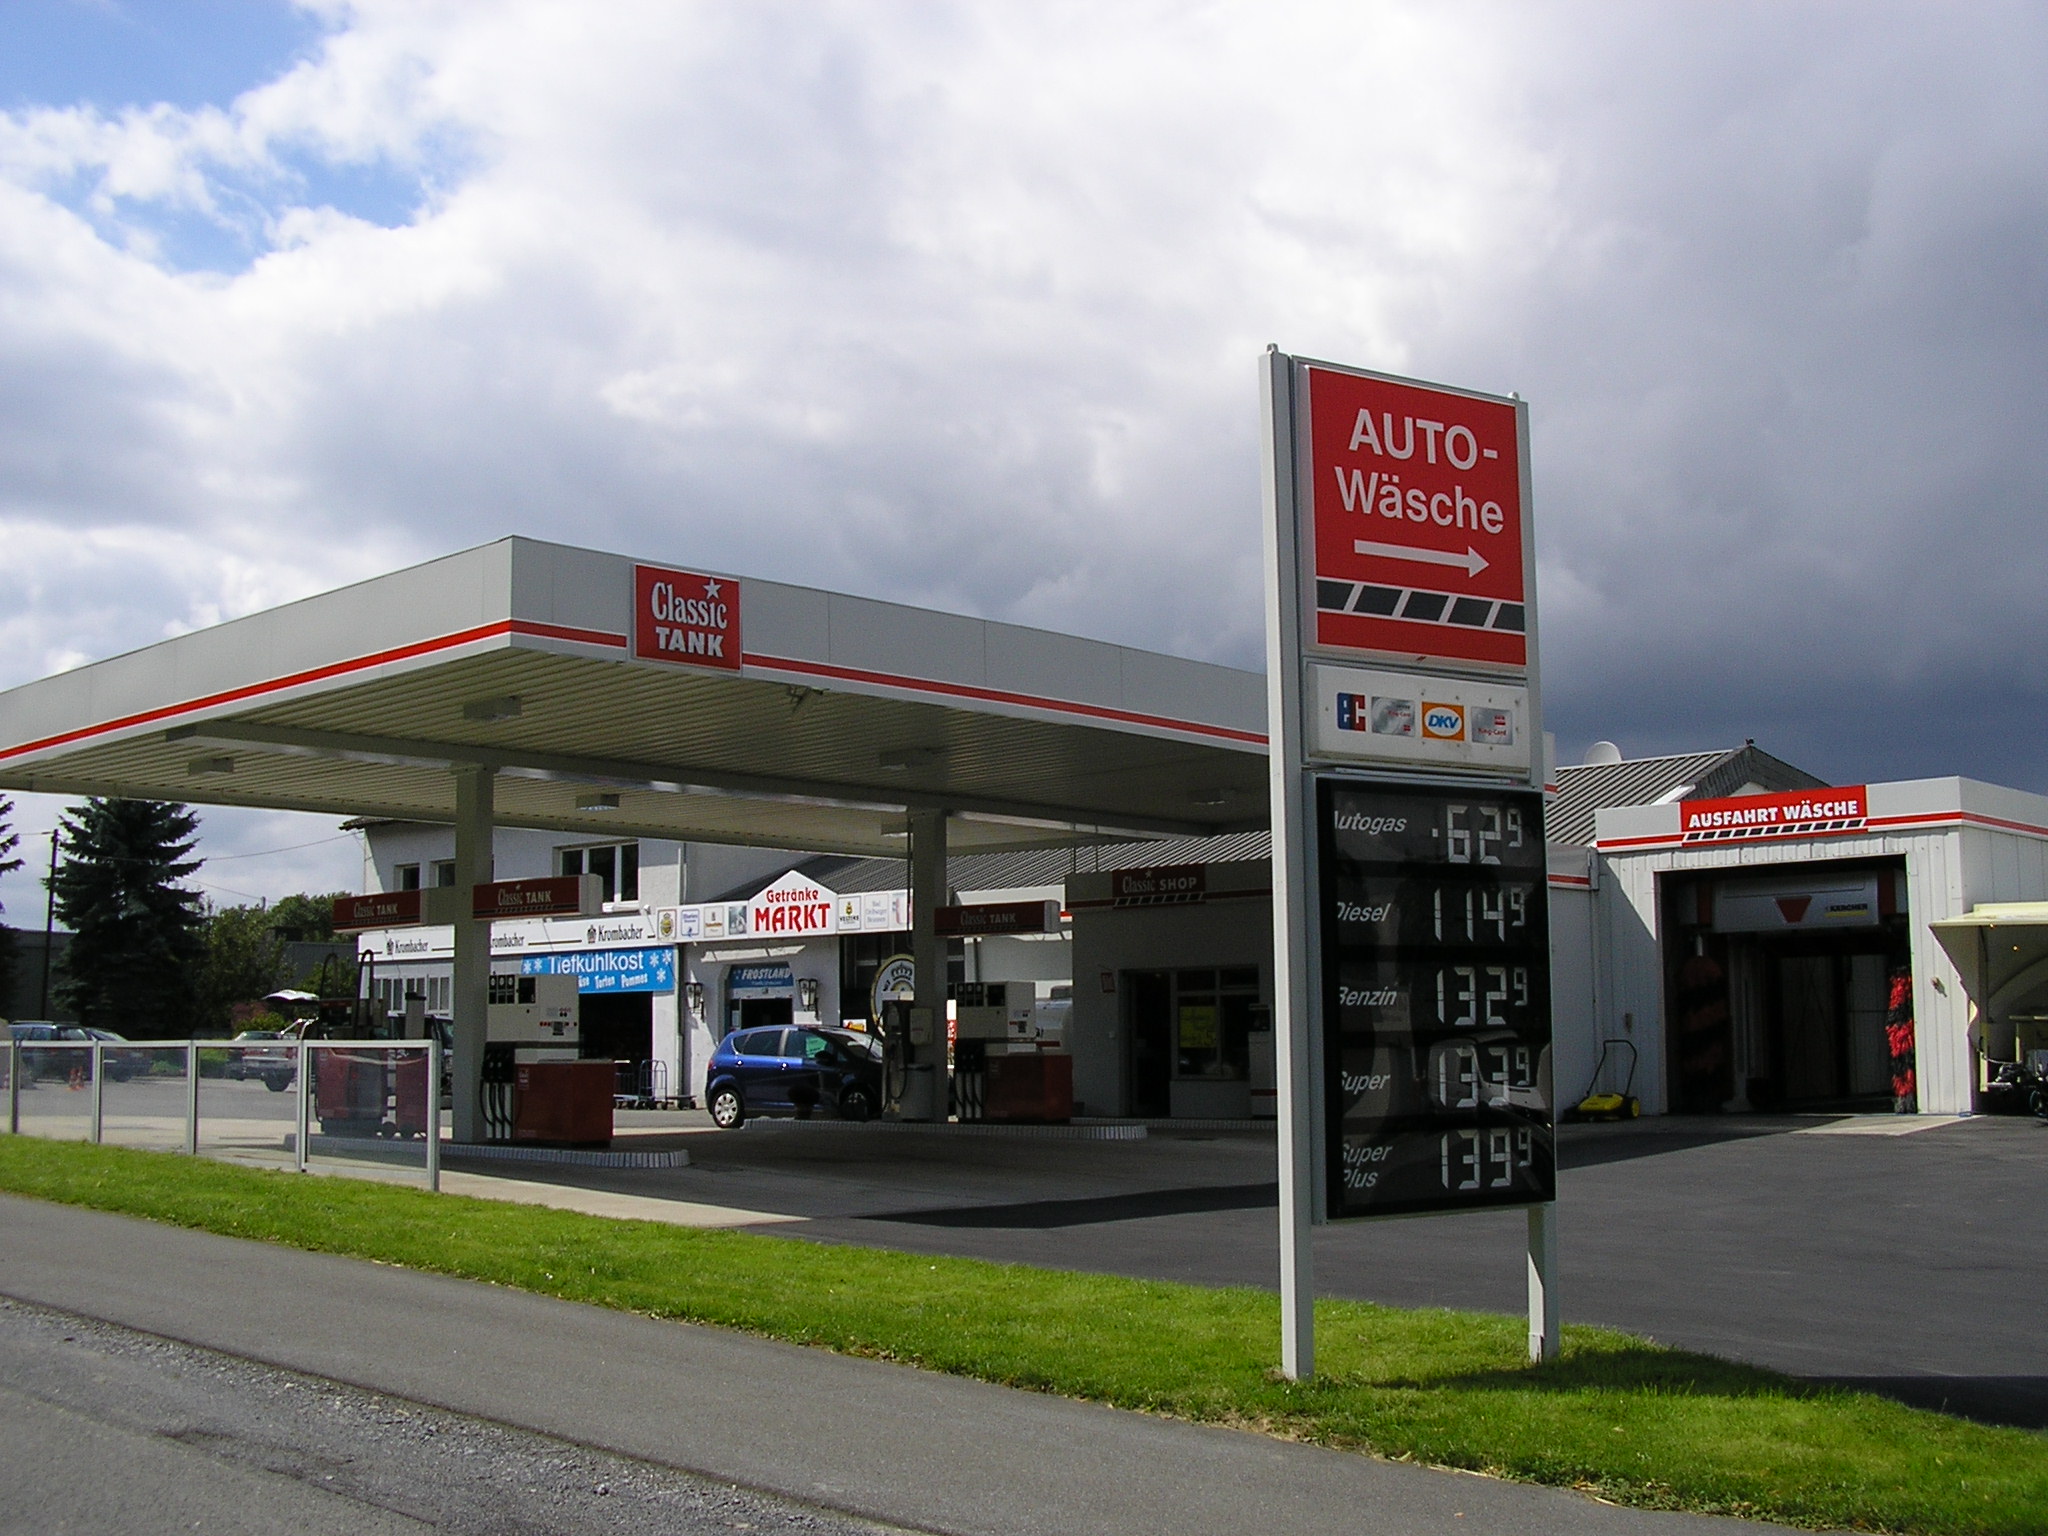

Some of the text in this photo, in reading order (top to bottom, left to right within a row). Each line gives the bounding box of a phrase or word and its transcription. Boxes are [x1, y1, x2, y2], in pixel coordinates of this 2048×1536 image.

[1347, 407, 1499, 471] AUTO-
[1333, 465, 1505, 535] Wäsche
[651, 581, 728, 630] Classic
[655, 626, 725, 658] TANK
[1427, 714, 1460, 730] DKV
[1688, 800, 1858, 829] AUSFAHRT WÄSCHE
[1122, 875, 1198, 894] Classic SHOP
[498, 888, 552, 906] Classic TANK
[766, 887, 819, 904] Getränke
[376, 903, 399, 916] TANK
[754, 903, 831, 933] MARKT
[989, 912, 1017, 924] TANK
[491, 931, 525, 949] rombacher
[598, 923, 644, 943] Krombacher
[547, 950, 644, 975] Tiefkühlkost
[620, 973, 648, 988] Pommes
[741, 967, 791, 981] FROSTLAND
